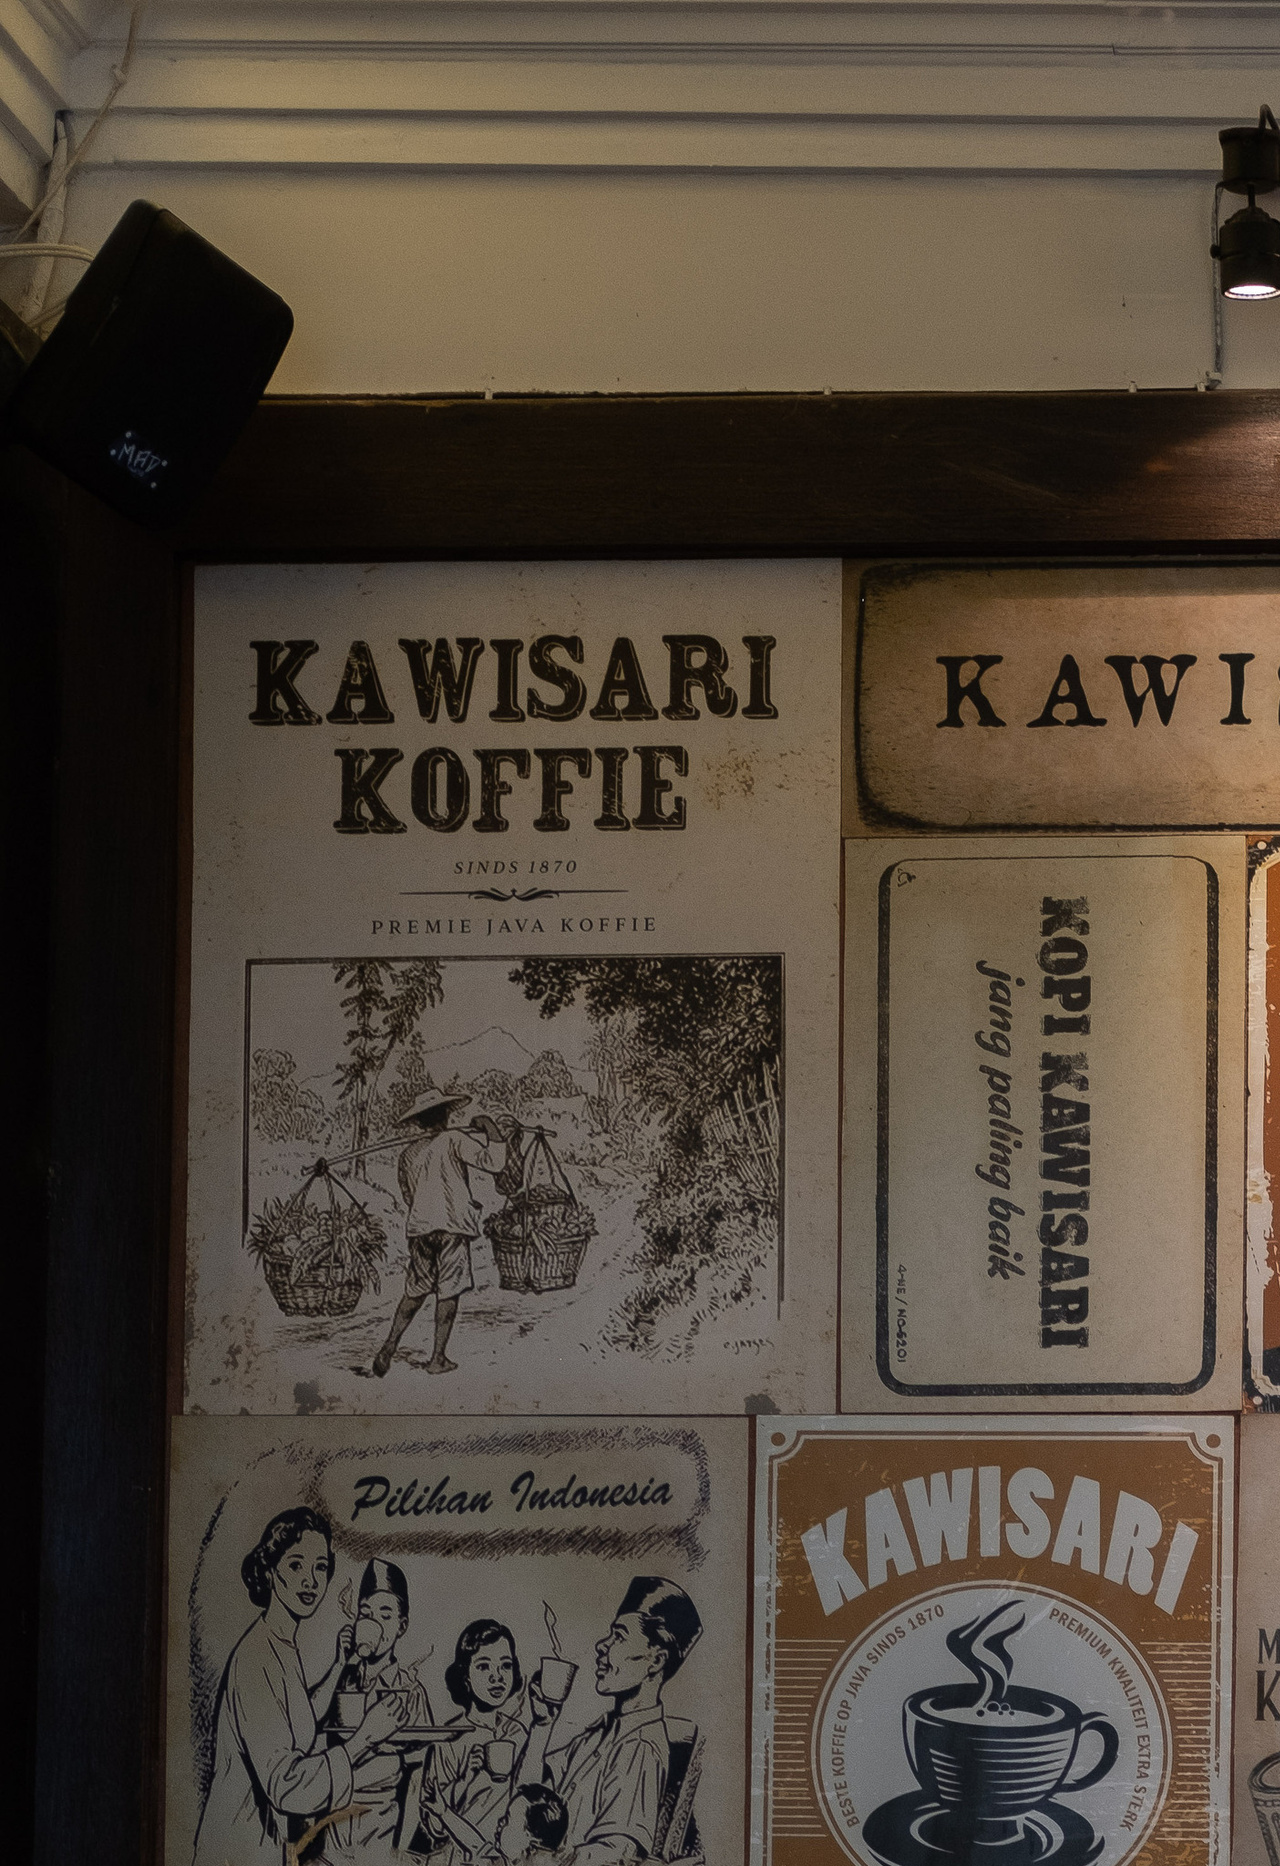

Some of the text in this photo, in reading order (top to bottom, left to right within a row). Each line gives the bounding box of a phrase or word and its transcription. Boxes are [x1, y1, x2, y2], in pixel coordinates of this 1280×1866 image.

[249, 634, 779, 726] KAWISARI
[333, 745, 689, 834] KOFFIE
[371, 917, 657, 936] PREMIE JAVA KOFFIE
[453, 859, 577, 874] SINDS 1870
[975, 959, 1026, 1280] jang paling baik
[1037, 896, 1092, 1349] KOPI KAWISARI
[352, 1470, 673, 1521] Pilihan Indonesia
[799, 1464, 1200, 1617] KAWISARI
[831, 1604, 945, 1829] BESTE KOFFIE OP JAVA SINDS 1870
[1049, 1607, 1151, 1833] PREMIUM KWALITEIT EXTRA STERK
